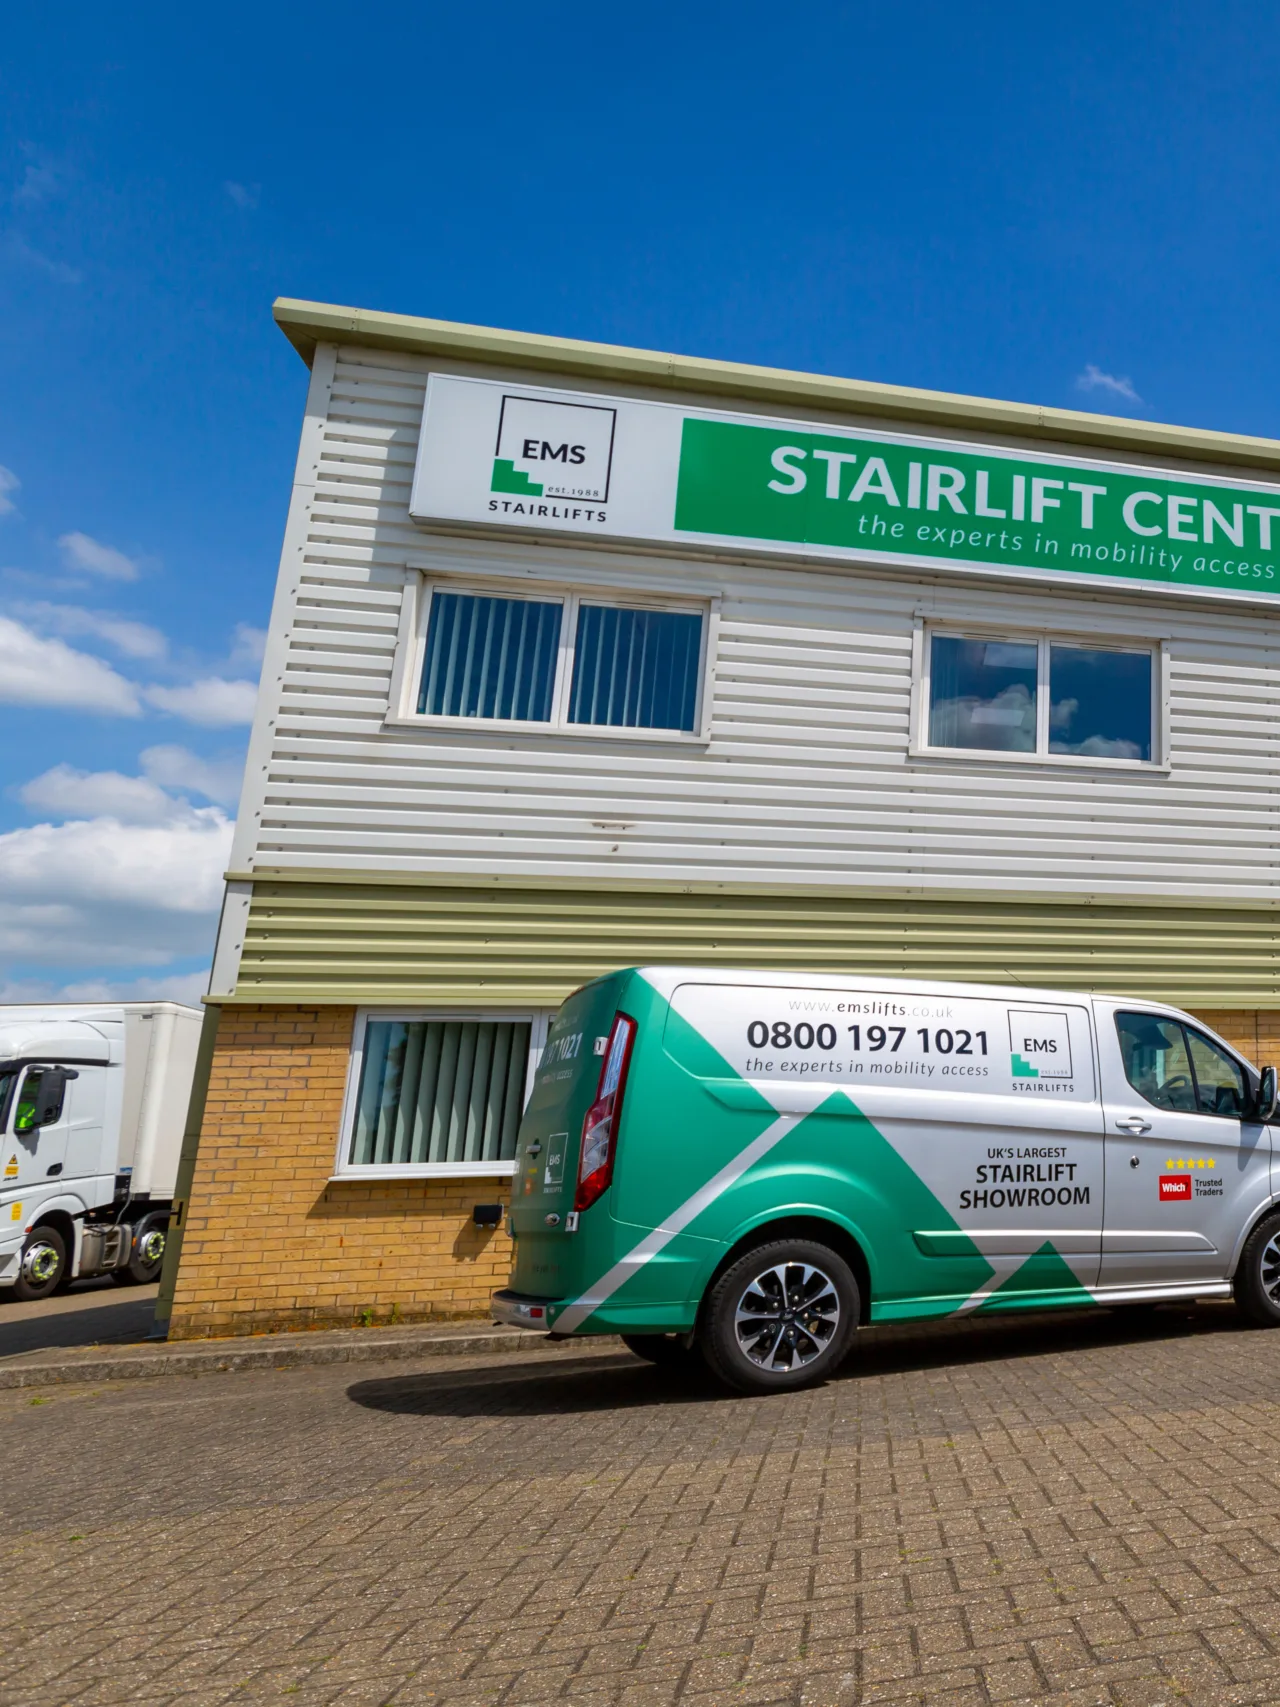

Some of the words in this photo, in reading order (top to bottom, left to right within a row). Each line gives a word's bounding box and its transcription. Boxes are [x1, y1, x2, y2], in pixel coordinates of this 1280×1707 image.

[522, 439, 586, 464] EMS
[548, 485, 599, 497] est.1988
[767, 446, 1107, 531] STAIRLIFT
[488, 500, 607, 522] STAIRLIFTS
[858, 514, 904, 537] the
[916, 524, 1022, 550] experts
[1035, 533, 1059, 555] in
[1070, 541, 1183, 572] mobility
[1193, 556, 1275, 579] access
[788, 1000, 954, 1019] www.emslifts.co.uk
[746, 1020, 838, 1051] 0800
[847, 1025, 907, 1053] 197
[917, 1028, 988, 1056] 1021
[1023, 1038, 1058, 1053] EMS
[746, 1058, 774, 1072] the
[780, 1060, 843, 1075] experts
[849, 1060, 864, 1073] in
[870, 1061, 936, 1077] mobility
[941, 1065, 989, 1077] access
[1012, 1083, 1074, 1093] STAIRLIFTS
[1017, 1147, 1067, 1158] LARGEST
[976, 1163, 1077, 1184] STAIRLIFT
[1195, 1178, 1223, 1187] Trusted
[959, 1186, 1090, 1209] SHOWROOM
[1195, 1188, 1223, 1196] Traders
